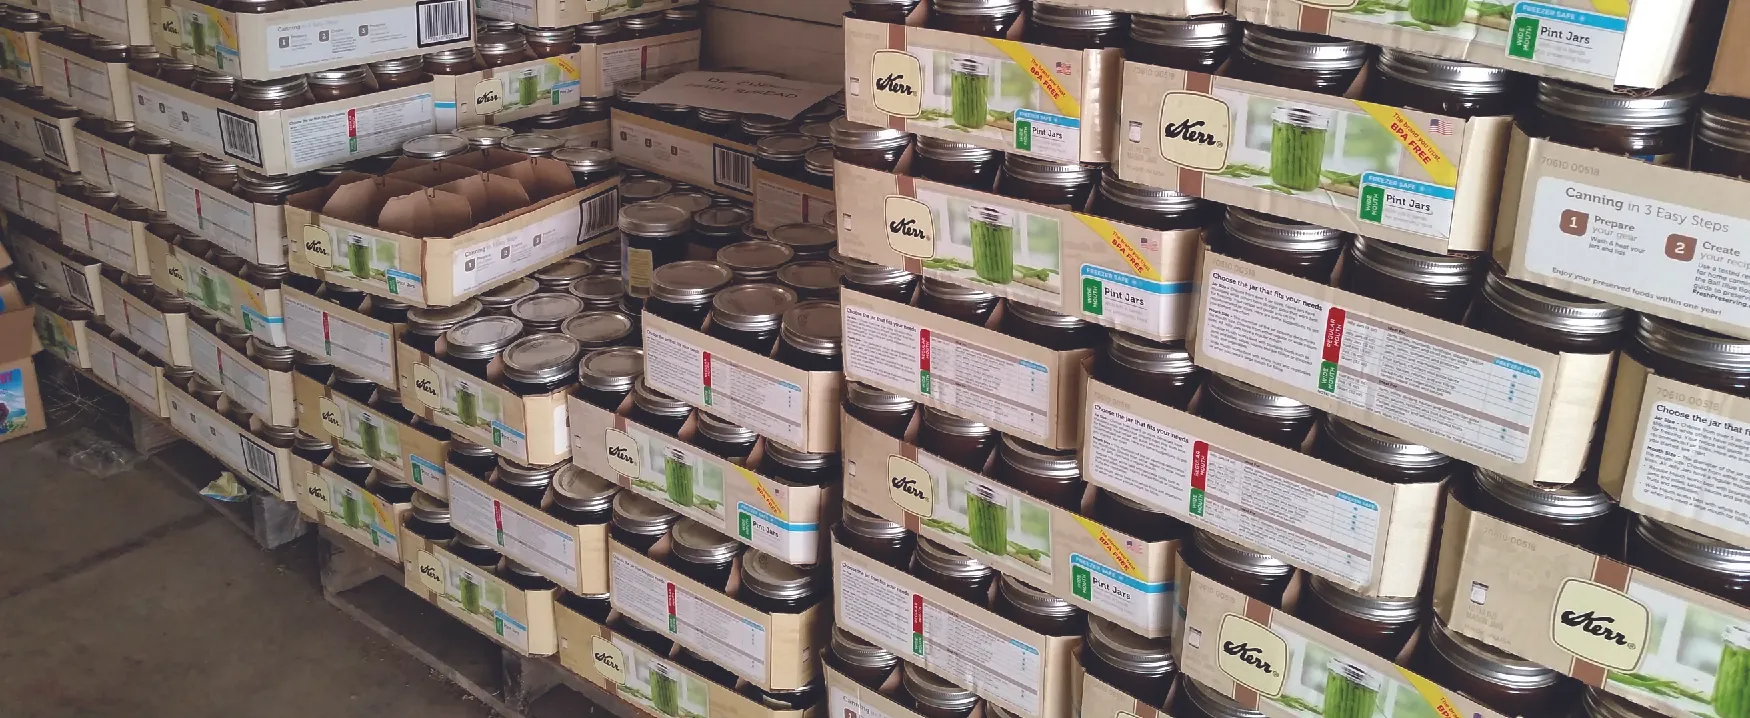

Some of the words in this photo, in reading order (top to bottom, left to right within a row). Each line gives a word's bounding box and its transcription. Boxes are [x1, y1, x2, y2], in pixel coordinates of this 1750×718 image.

[1522, 5, 1555, 16] FREEZER
[1556, 11, 1575, 20] SAFE
[1517, 28, 1525, 46] WIDE
[1523, 26, 1533, 51] MOUTH
[1540, 26, 1563, 39] Pint
[1566, 31, 1590, 44] Jars
[876, 72, 912, 96] Kerr
[1030, 66, 1043, 81] BPA
[1042, 79, 1060, 100] FREE
[1032, 127, 1046, 136] Pint
[1048, 130, 1063, 139] Jars
[1164, 118, 1216, 146] Kerr
[1393, 112, 1404, 123] The
[1404, 121, 1420, 138] brand
[1418, 135, 1429, 149] you
[1390, 122, 1408, 141] BPA
[1408, 140, 1432, 165] FREE
[1540, 157, 1569, 170] 70610
[1571, 163, 1600, 176] 00518
[1368, 175, 1398, 186] FREEZER
[1399, 182, 1416, 190] SAFE
[1372, 194, 1380, 216] MOUTH
[1386, 194, 1406, 206] Pint
[1409, 199, 1431, 212] Jars
[1565, 187, 1624, 211] Canning
[1627, 201, 1640, 213] in
[1644, 204, 1653, 216] 3
[1656, 206, 1688, 225] Easy
[1691, 214, 1730, 233] Steps
[890, 217, 926, 240] Kerr
[1569, 216, 1578, 228] 1
[1594, 215, 1636, 232] Prepare
[1590, 236, 1608, 244] Wash
[1615, 242, 1630, 250] heat
[1592, 226, 1614, 236] your
[1616, 231, 1638, 242] gear
[1111, 238, 1126, 254] BPA
[1126, 253, 1144, 274] FREE
[1674, 242, 1685, 254] 2
[1700, 252, 1724, 262] your
[1702, 241, 1741, 257] Create
[1086, 267, 1113, 279] FREEZER
[1113, 274, 1129, 283] SAFE
[1104, 287, 1122, 300] Pint
[1124, 294, 1144, 306] Jars
[1212, 272, 1237, 285] Choose
[1237, 280, 1248, 289] the
[1259, 286, 1273, 296] that
[1274, 290, 1285, 300] fits
[1285, 294, 1301, 304] your
[1302, 300, 1323, 312] needs
[1552, 266, 1573, 279] Enjoy
[1574, 274, 1591, 282] your
[1592, 279, 1631, 293] preserved
[1632, 288, 1654, 299] foods
[1655, 294, 1682, 307] within
[1683, 302, 1699, 310] one
[1326, 318, 1336, 348] REGULAR
[1334, 323, 1342, 347] MOUTH
[1094, 404, 1115, 416] Choose
[1115, 412, 1126, 420] the
[1134, 419, 1147, 428] that
[1147, 423, 1156, 432] fits
[1156, 427, 1170, 437] your
[1171, 433, 1189, 444] needs
[1656, 404, 1690, 420] Choose
[1692, 414, 1708, 424] the
[1708, 418, 1722, 428] jar
[1724, 423, 1743, 434] that
[892, 476, 925, 499] Kerr
[1092, 576, 1110, 591] Pint
[1112, 584, 1131, 600] Jars
[1561, 610, 1628, 646] Kerr
[1223, 640, 1272, 674] Kerr
[1440, 696, 1450, 709] The
